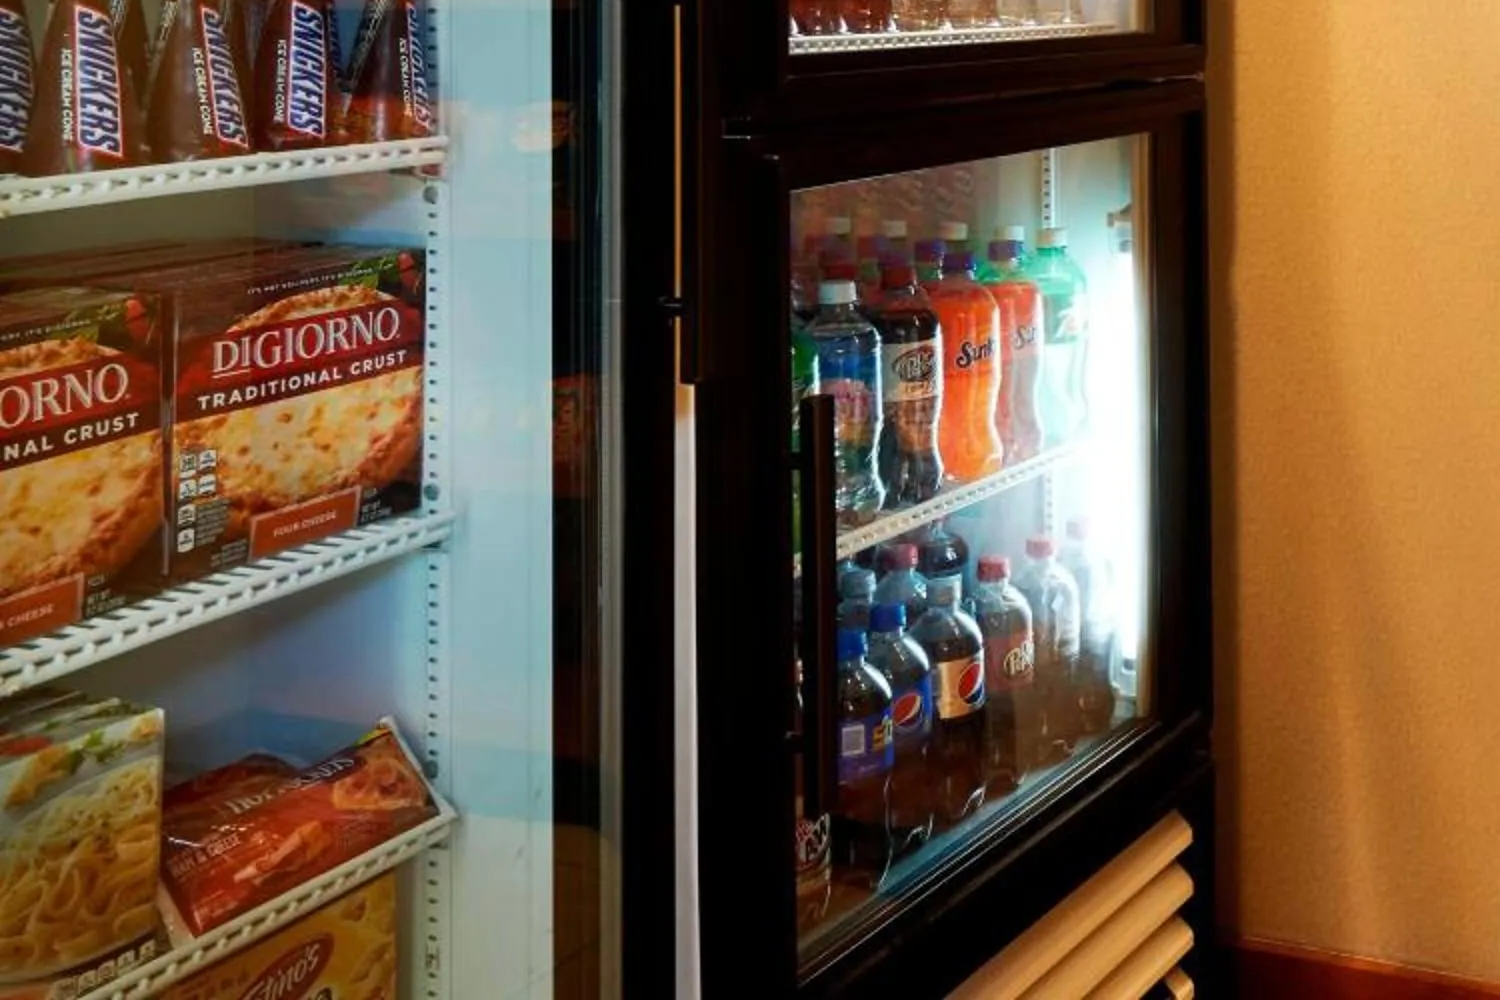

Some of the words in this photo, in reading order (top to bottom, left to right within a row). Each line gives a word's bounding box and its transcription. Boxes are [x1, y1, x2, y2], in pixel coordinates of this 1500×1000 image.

[78, 10, 121, 153] SNICKERS
[206, 12, 248, 145] SNICKERS
[289, 6, 324, 135] SNICKERS
[198, 366, 343, 412] TRADITIONAL
[350, 349, 408, 378] CRUST
[212, 306, 400, 376] DIGIORNO
[64, 411, 140, 445] CRUST
